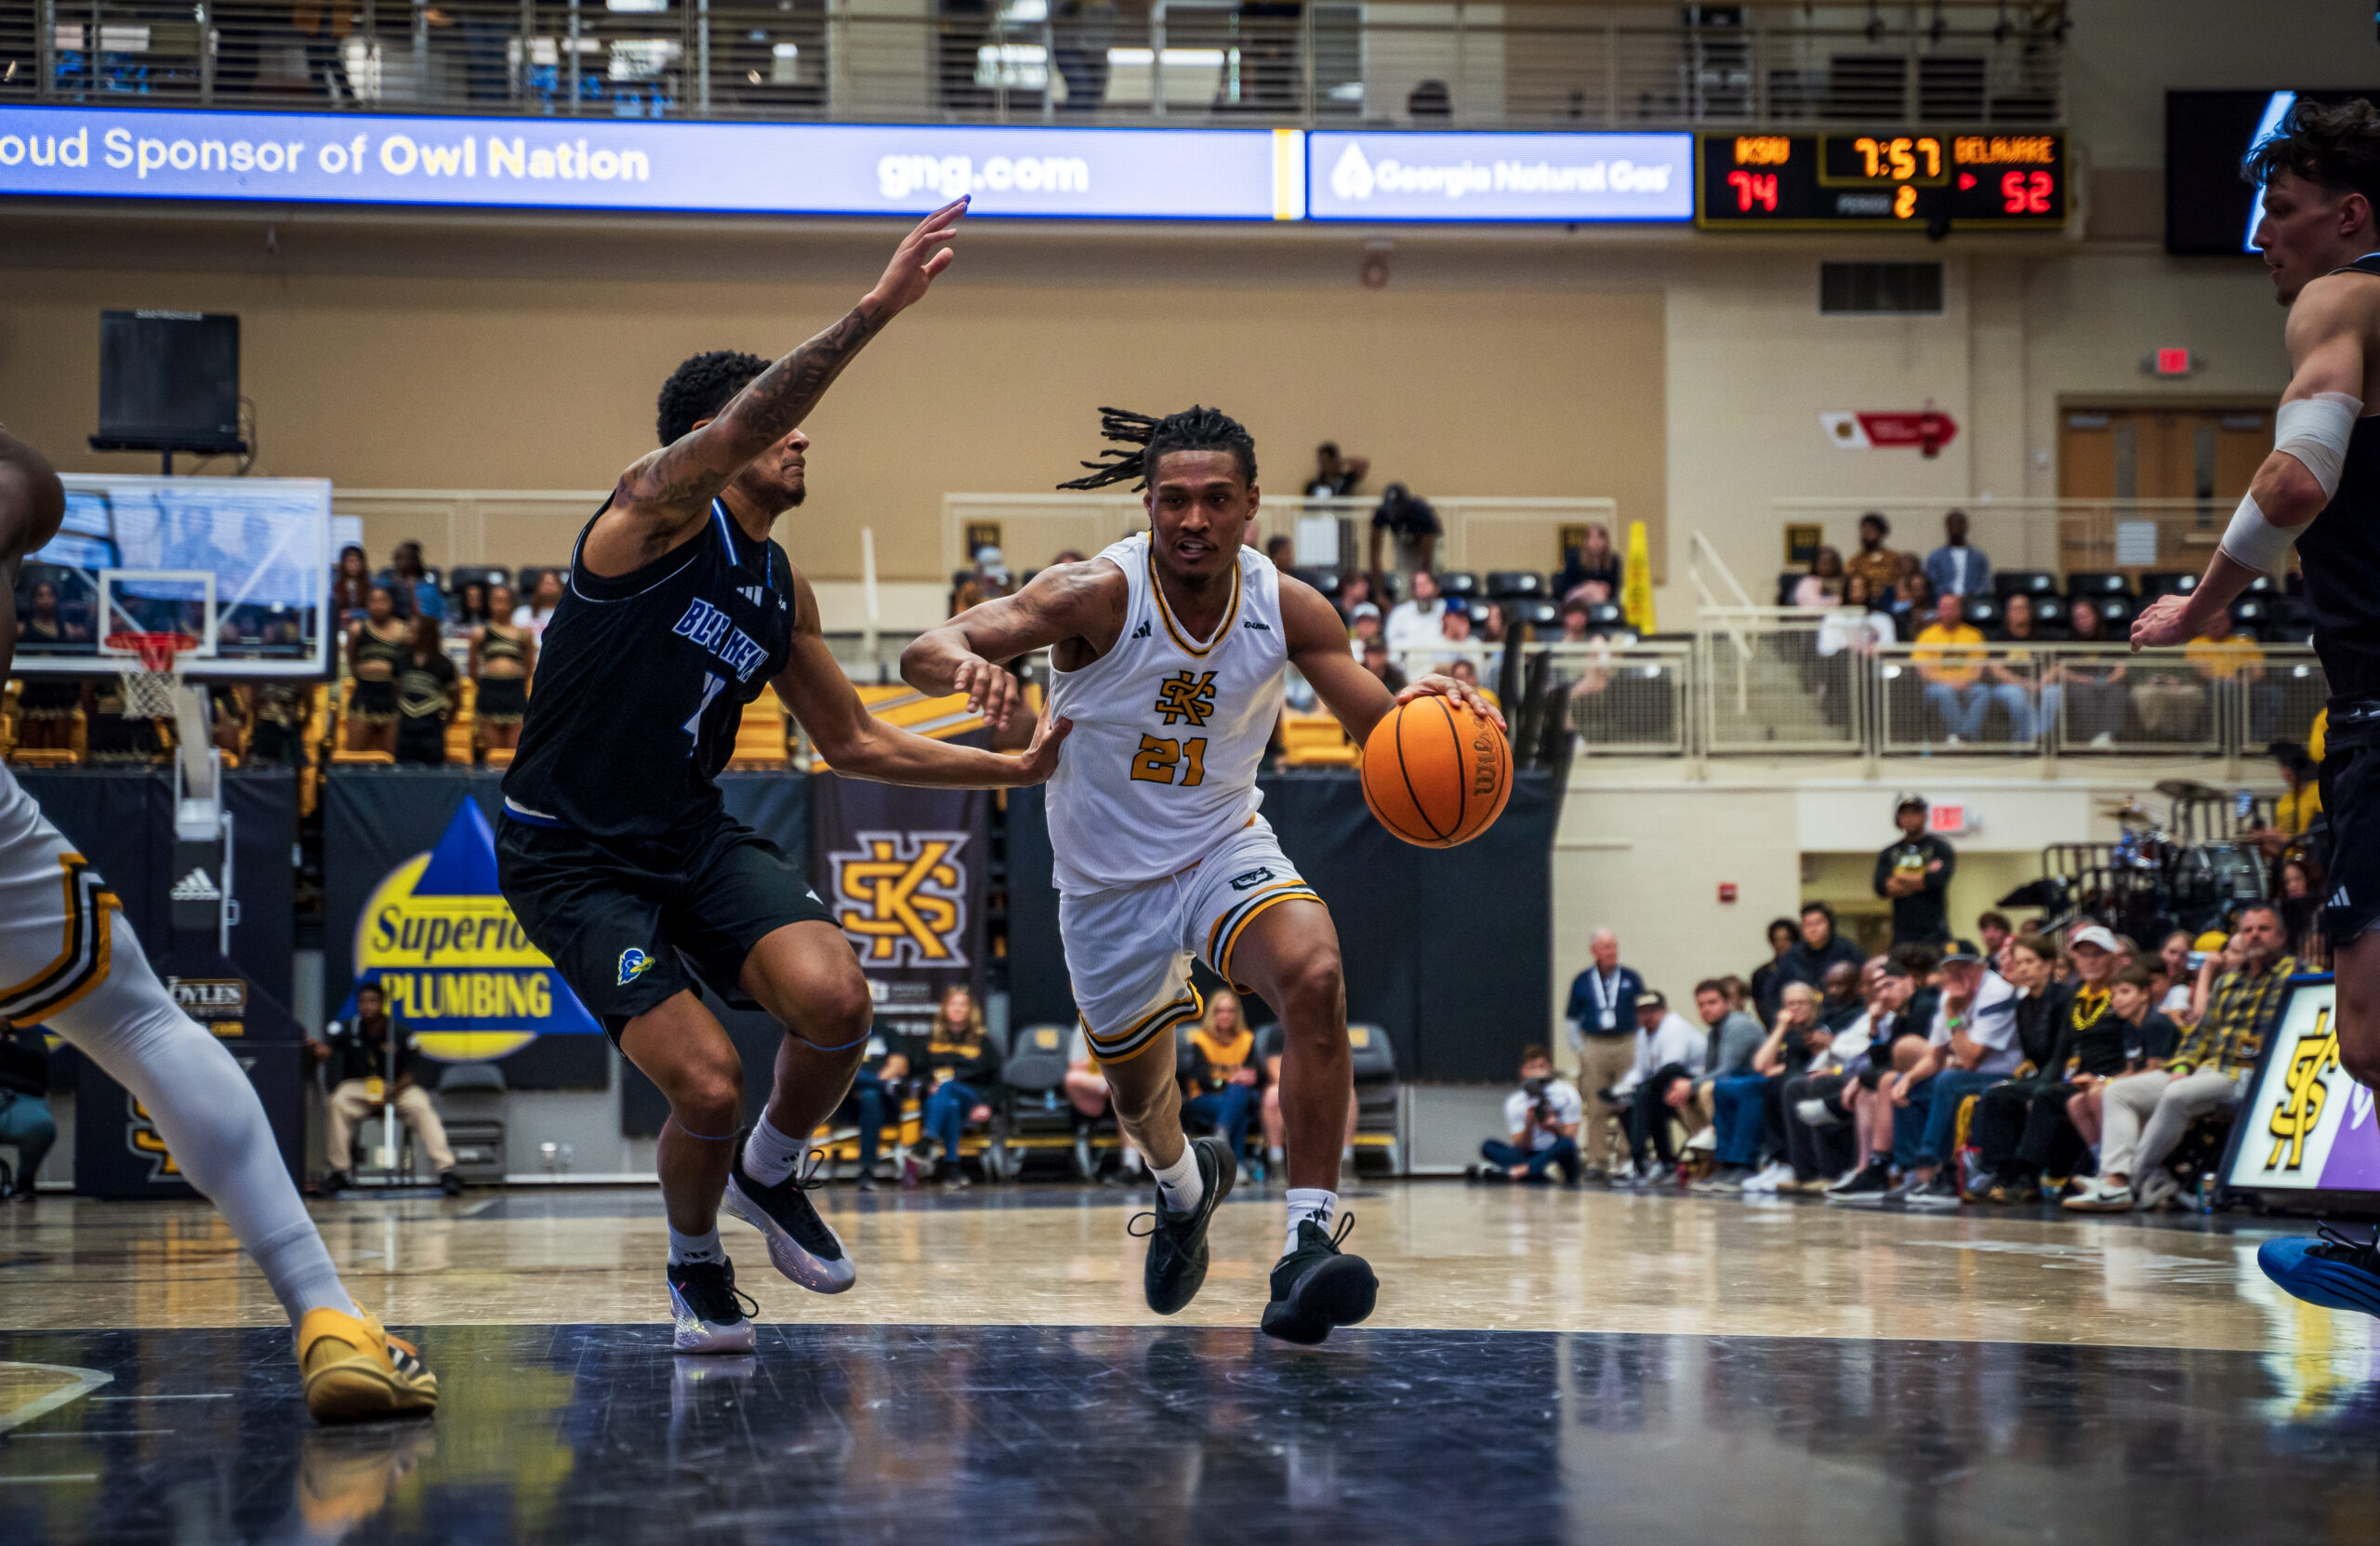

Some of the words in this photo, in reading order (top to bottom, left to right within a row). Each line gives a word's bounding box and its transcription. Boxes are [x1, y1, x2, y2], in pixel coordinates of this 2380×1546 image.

[104, 127, 305, 179] Sponsor
[319, 131, 368, 175] of
[379, 134, 477, 178] Owl
[488, 137, 650, 180] Nation
[1854, 138, 1940, 179] 7:57
[1954, 136, 2056, 165] DELAWARE
[878, 154, 1088, 199] gng.com
[1376, 158, 1491, 199] Georgia
[1493, 159, 1606, 192] Natural
[1607, 158, 1670, 192] Gas
[1727, 171, 1778, 212] 74
[2001, 171, 2054, 213] 52
[1894, 185, 1917, 218] 2
[1130, 733, 1208, 786] 21
[373, 904, 529, 963] Superio
[380, 972, 552, 1018] PLUMBING
